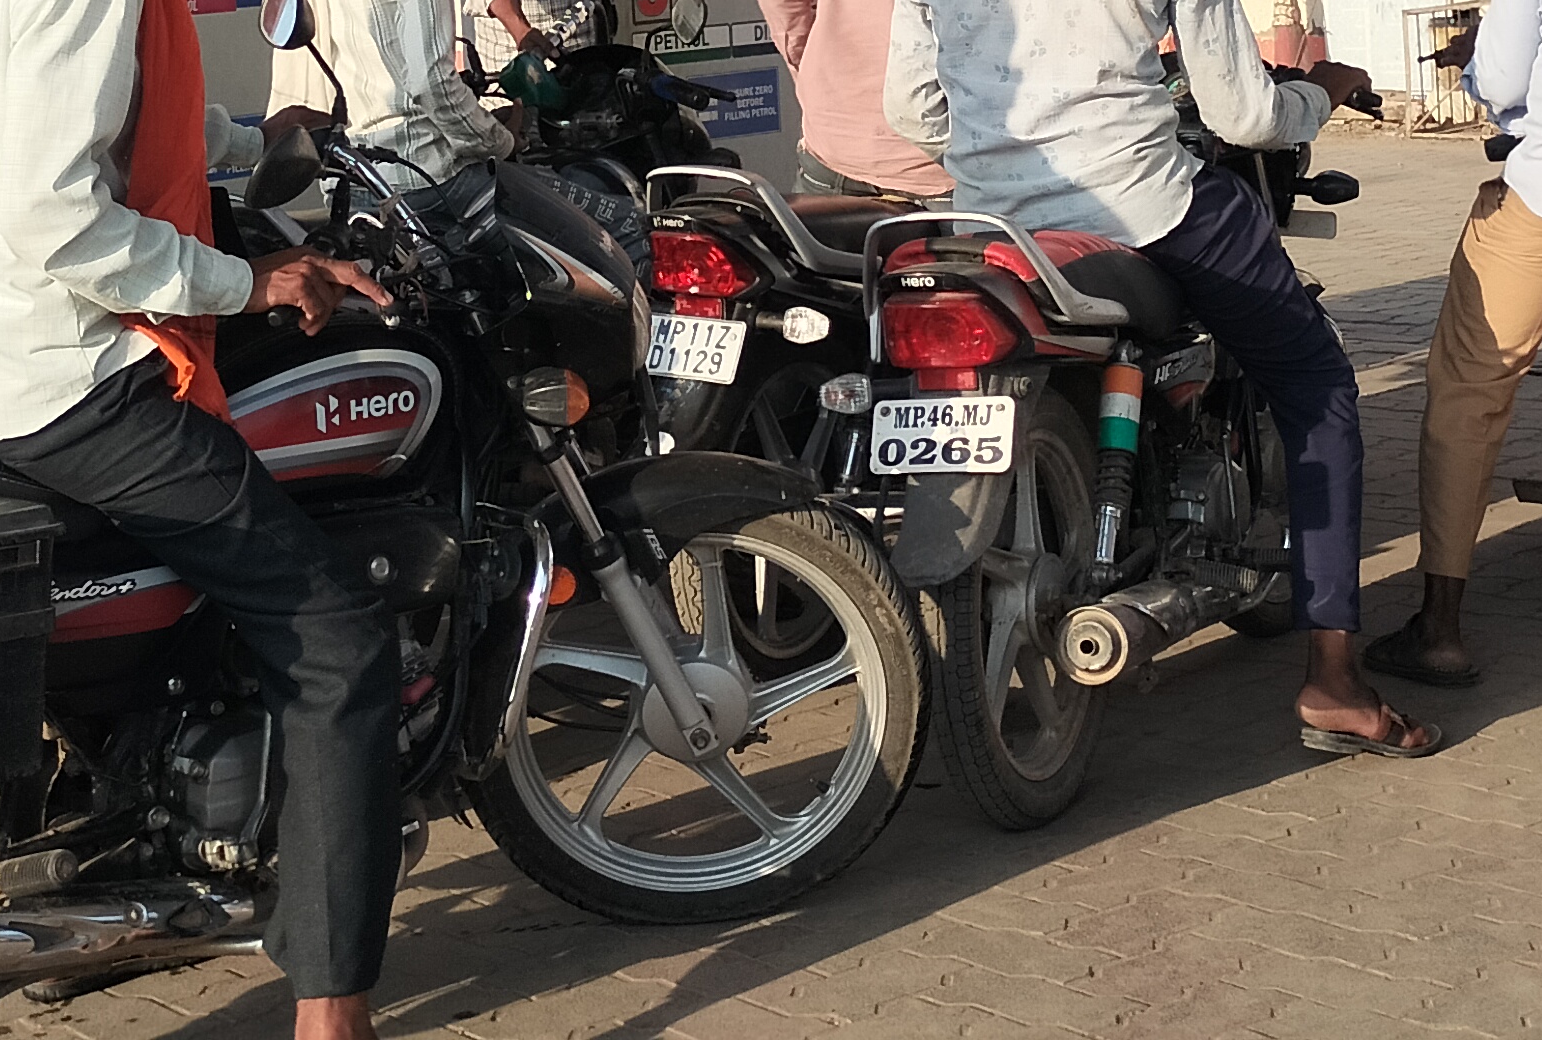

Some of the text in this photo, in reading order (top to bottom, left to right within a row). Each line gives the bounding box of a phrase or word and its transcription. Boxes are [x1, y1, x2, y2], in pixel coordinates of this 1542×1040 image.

[653, 30, 710, 52] PETOL
[754, 85, 774, 96] ZERO
[736, 97, 765, 109] BEFORE
[724, 110, 751, 121] FILLING
[751, 107, 777, 118] PETROL
[662, 219, 685, 228] Hero
[900, 275, 936, 288] Hero
[655, 318, 732, 350] MP11Z
[649, 344, 723, 375] D1129
[349, 390, 416, 421] Hero
[877, 435, 1004, 467] 0265
